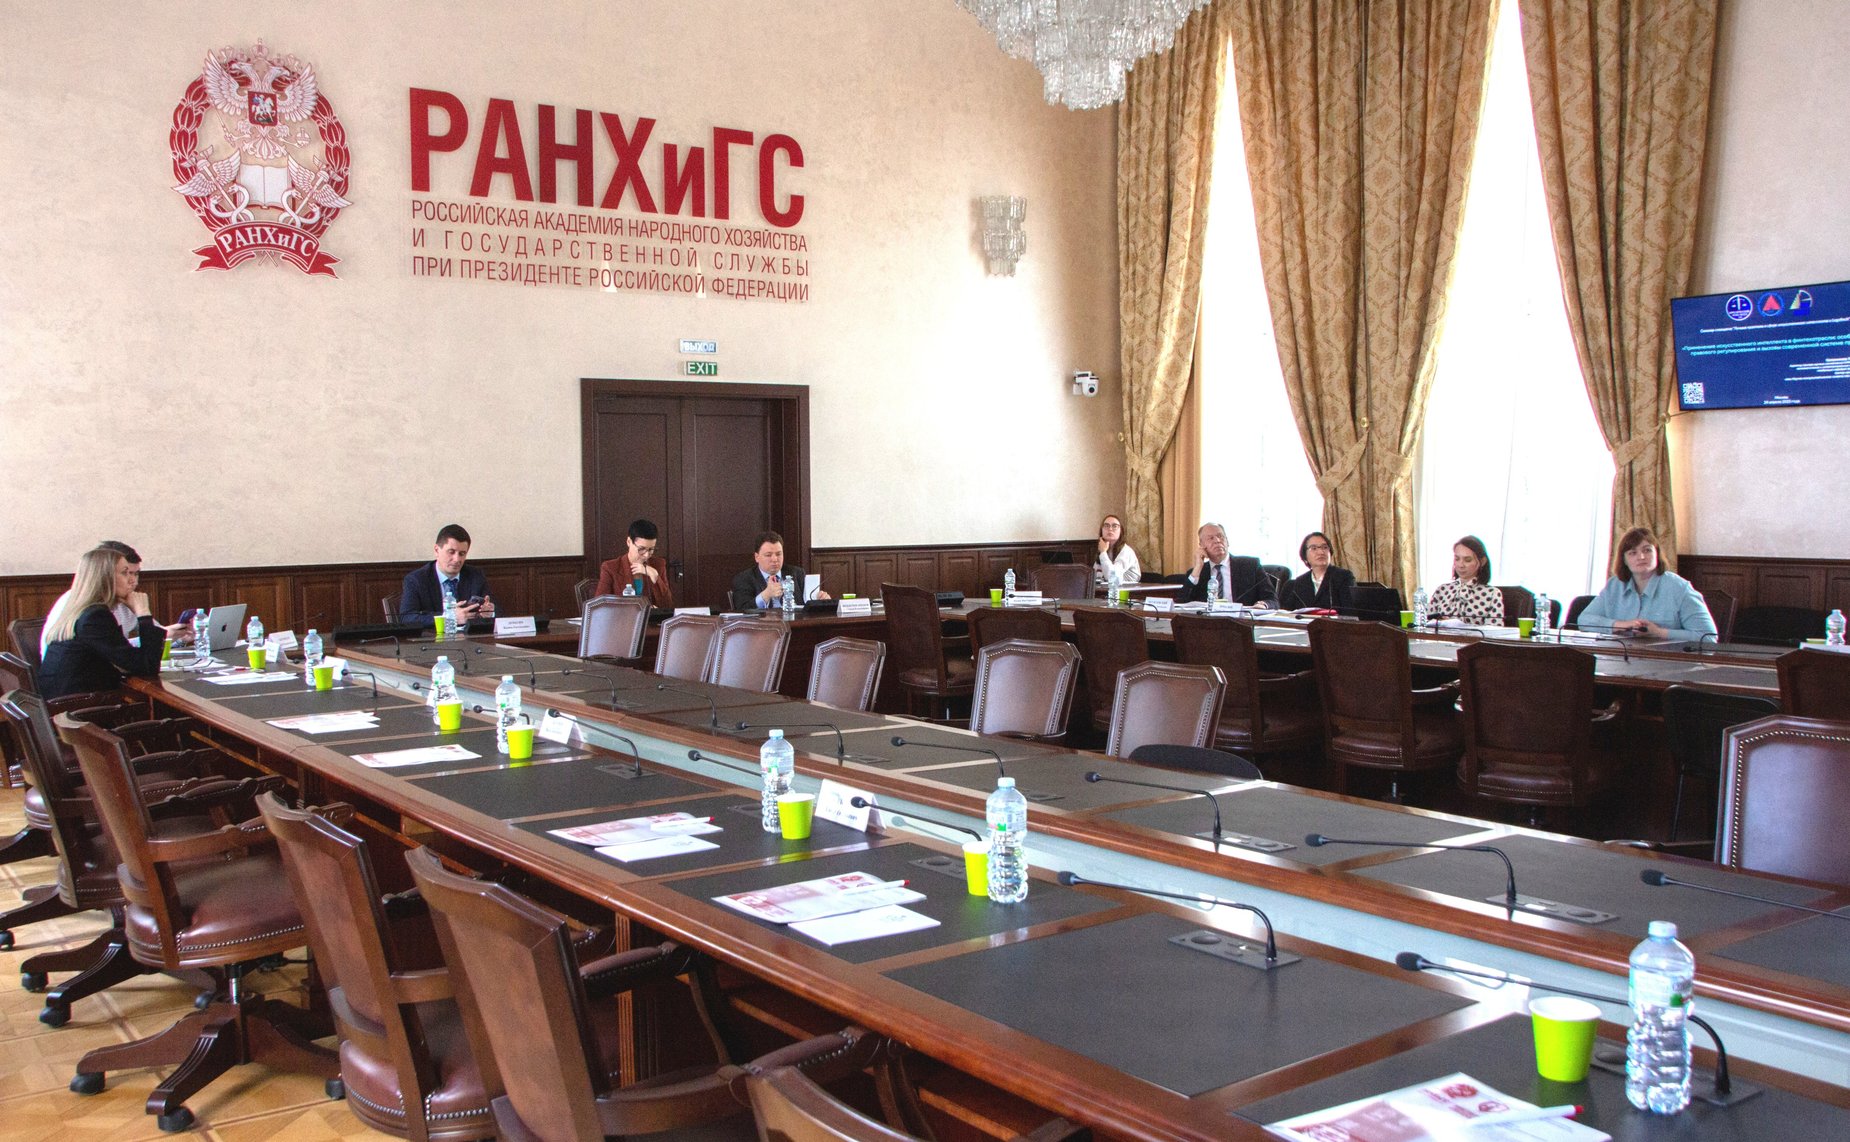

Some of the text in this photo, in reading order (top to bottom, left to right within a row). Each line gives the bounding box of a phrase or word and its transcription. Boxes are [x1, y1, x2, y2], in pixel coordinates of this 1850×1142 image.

[409, 87, 805, 228] РАНХиГС
[217, 226, 317, 257] РАНХиГС
[412, 200, 807, 252] РОССИЙСКАЯ АКАДЕМИЯ НАРОДНОГО ХОЗЯЙСТВА
[412, 228, 809, 276] И ГОСУДАРСТВЕННОЙ СЛУЖБЫ
[413, 256, 809, 303] ПРИ ПРЕЗИДЕНТЕ РОССИЙСКОЙ ФЕДЕРАЦИИ
[687, 362, 717, 375] EXIT
